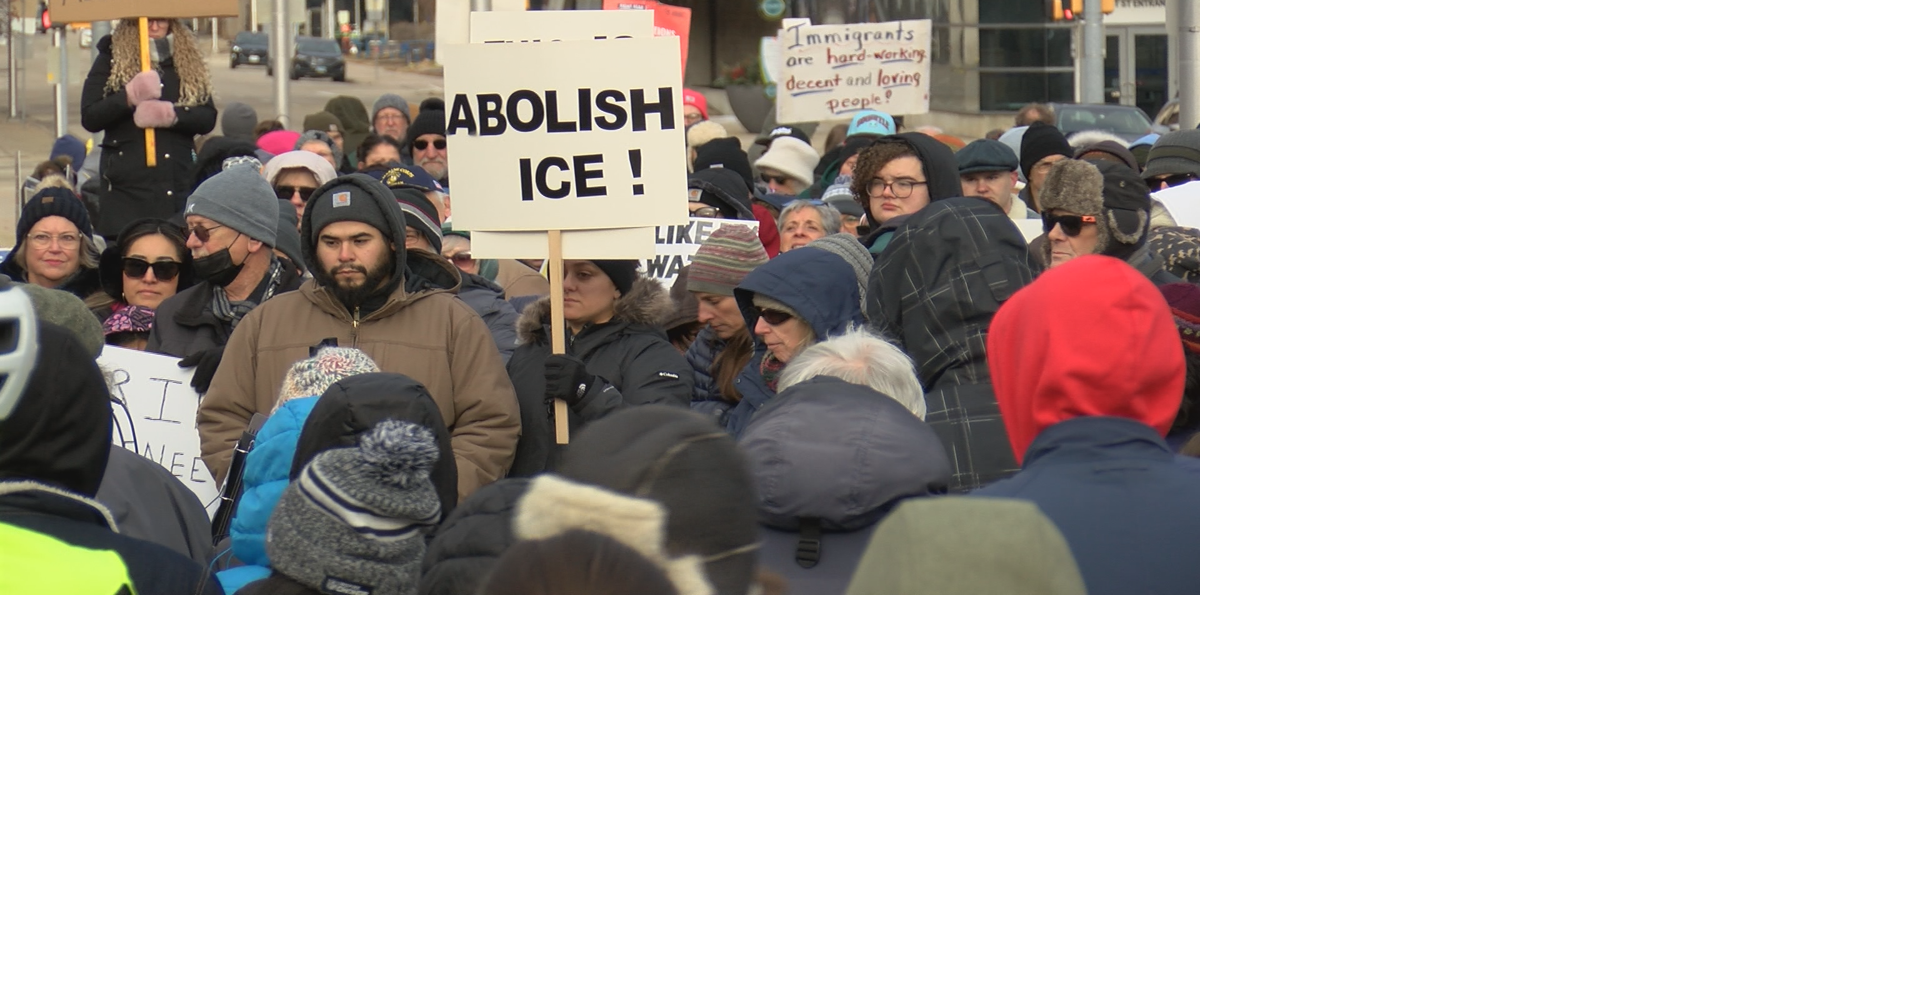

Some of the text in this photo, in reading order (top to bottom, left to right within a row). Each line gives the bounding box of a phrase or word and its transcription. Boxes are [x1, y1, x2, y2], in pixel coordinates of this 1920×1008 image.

[786, 21, 914, 50] Immigrants
[786, 55, 813, 67] are
[786, 69, 921, 91] decent and loving
[447, 87, 675, 137] ABOLISH
[519, 153, 607, 201] ICE
[655, 220, 714, 245] LIKE
[646, 255, 694, 279] WA
